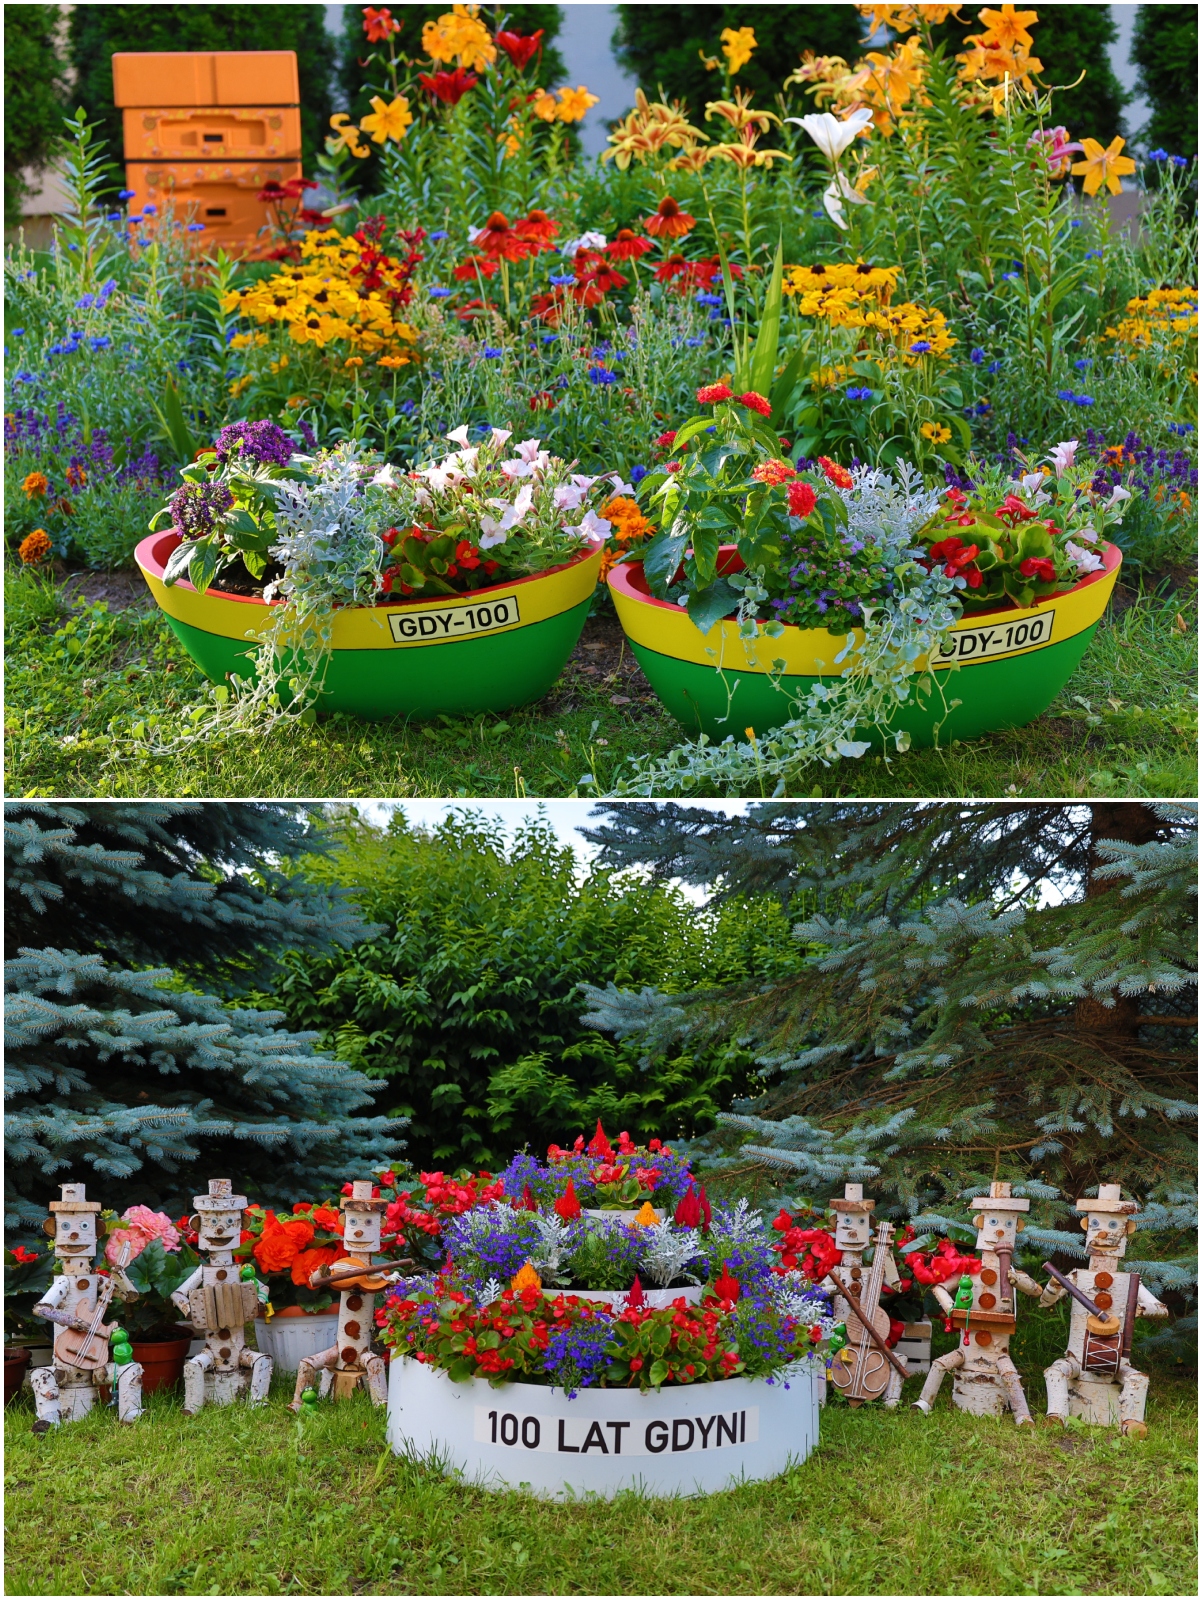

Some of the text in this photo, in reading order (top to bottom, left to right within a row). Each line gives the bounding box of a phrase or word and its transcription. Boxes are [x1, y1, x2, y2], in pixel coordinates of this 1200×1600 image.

[398, 603, 509, 637] GDY-100
[488, 1410, 746, 1455] 100 LAT GDYNI
